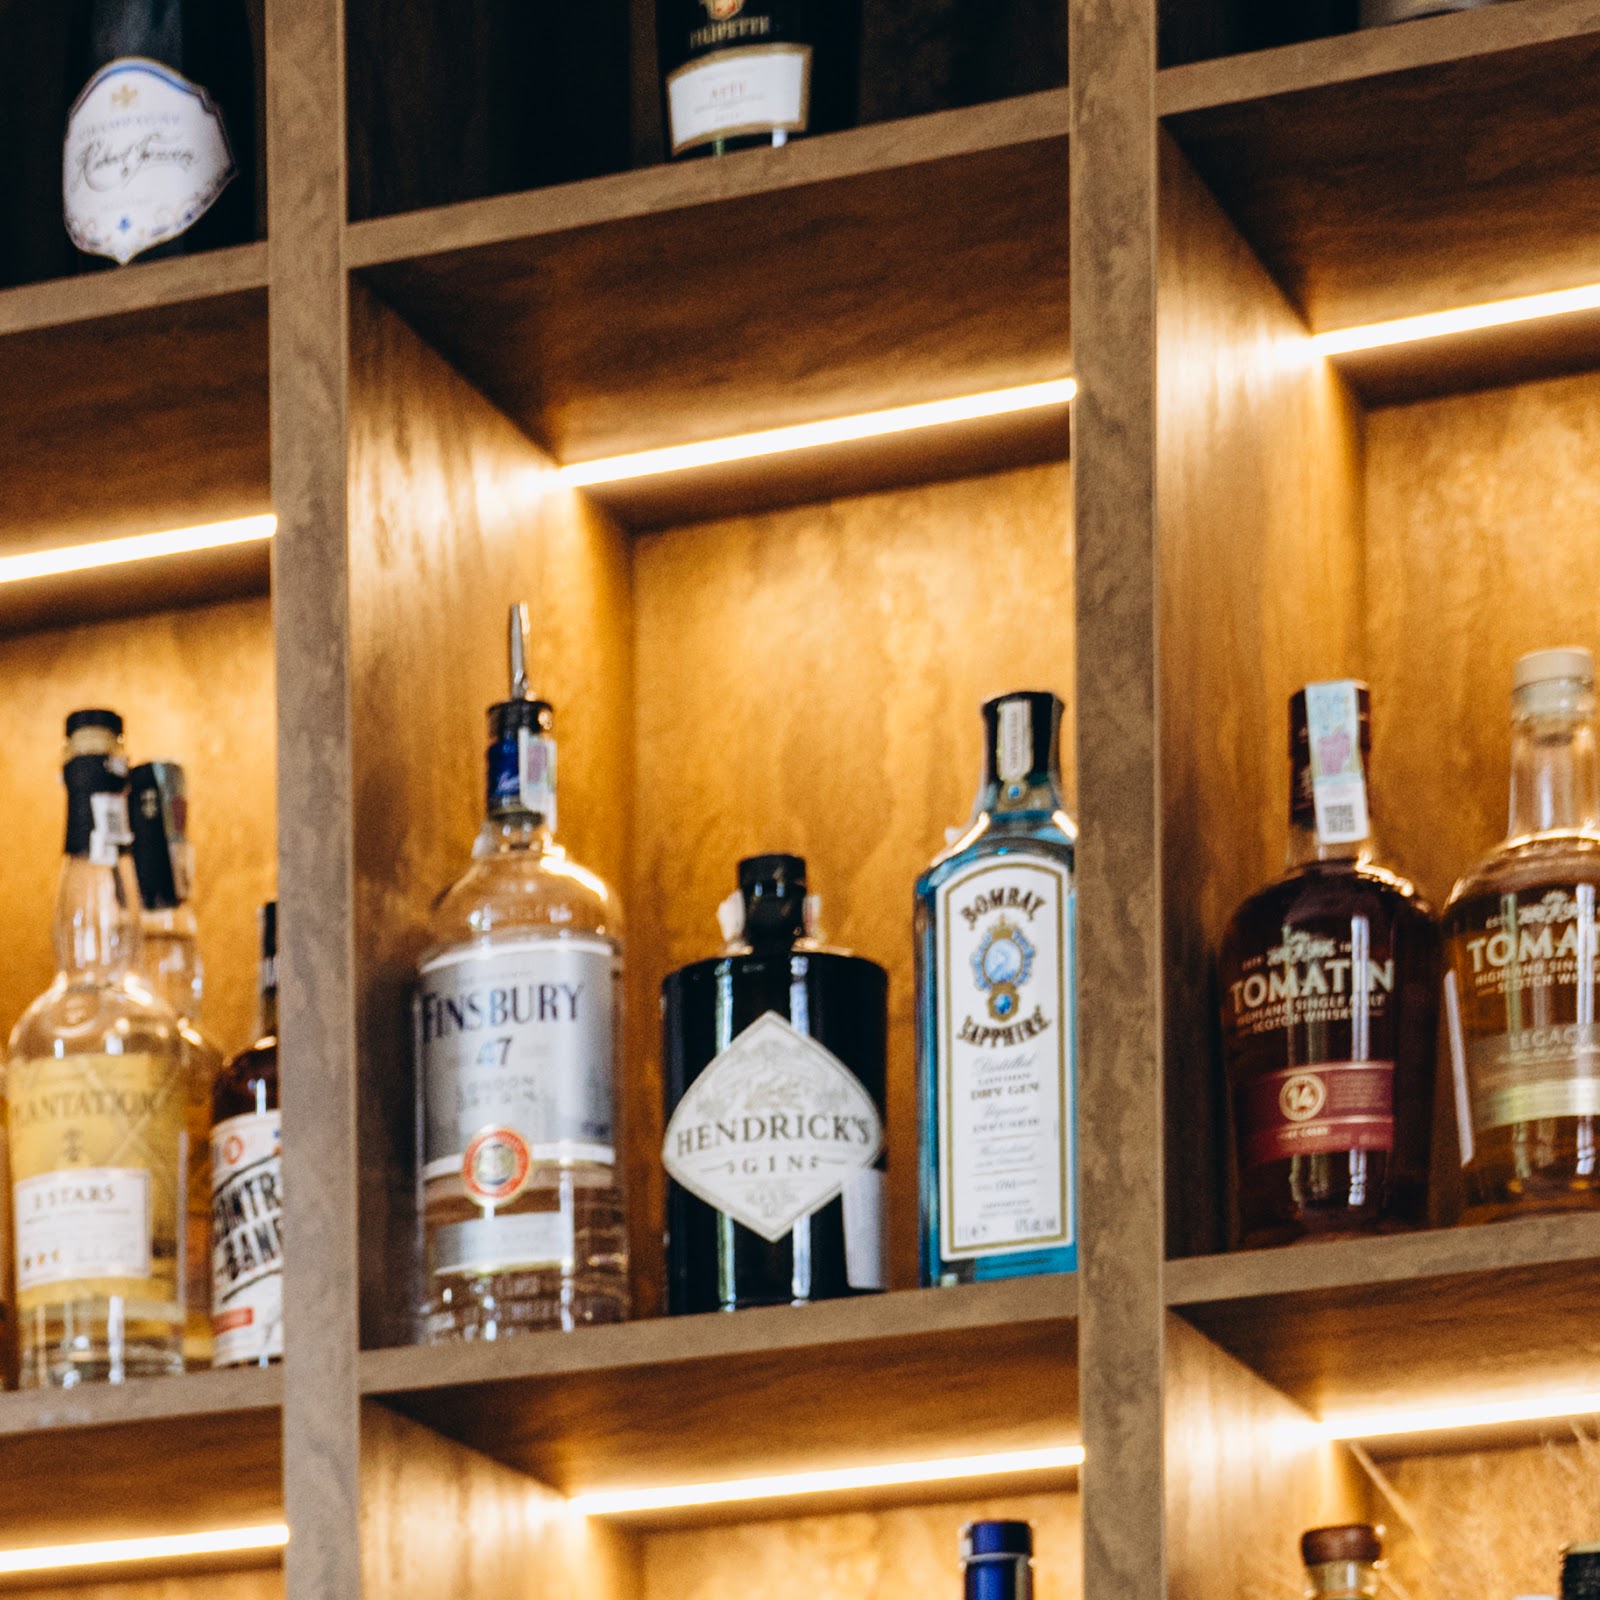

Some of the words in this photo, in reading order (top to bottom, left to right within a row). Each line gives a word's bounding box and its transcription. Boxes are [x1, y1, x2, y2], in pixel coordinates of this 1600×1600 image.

[960, 886, 1047, 931] BOMBAY
[421, 983, 586, 1044] FINSBURY
[956, 1003, 1053, 1049] SAPPHIRE
[676, 1111, 871, 1157] HENDRICK'S
[741, 1155, 803, 1174] GIN
